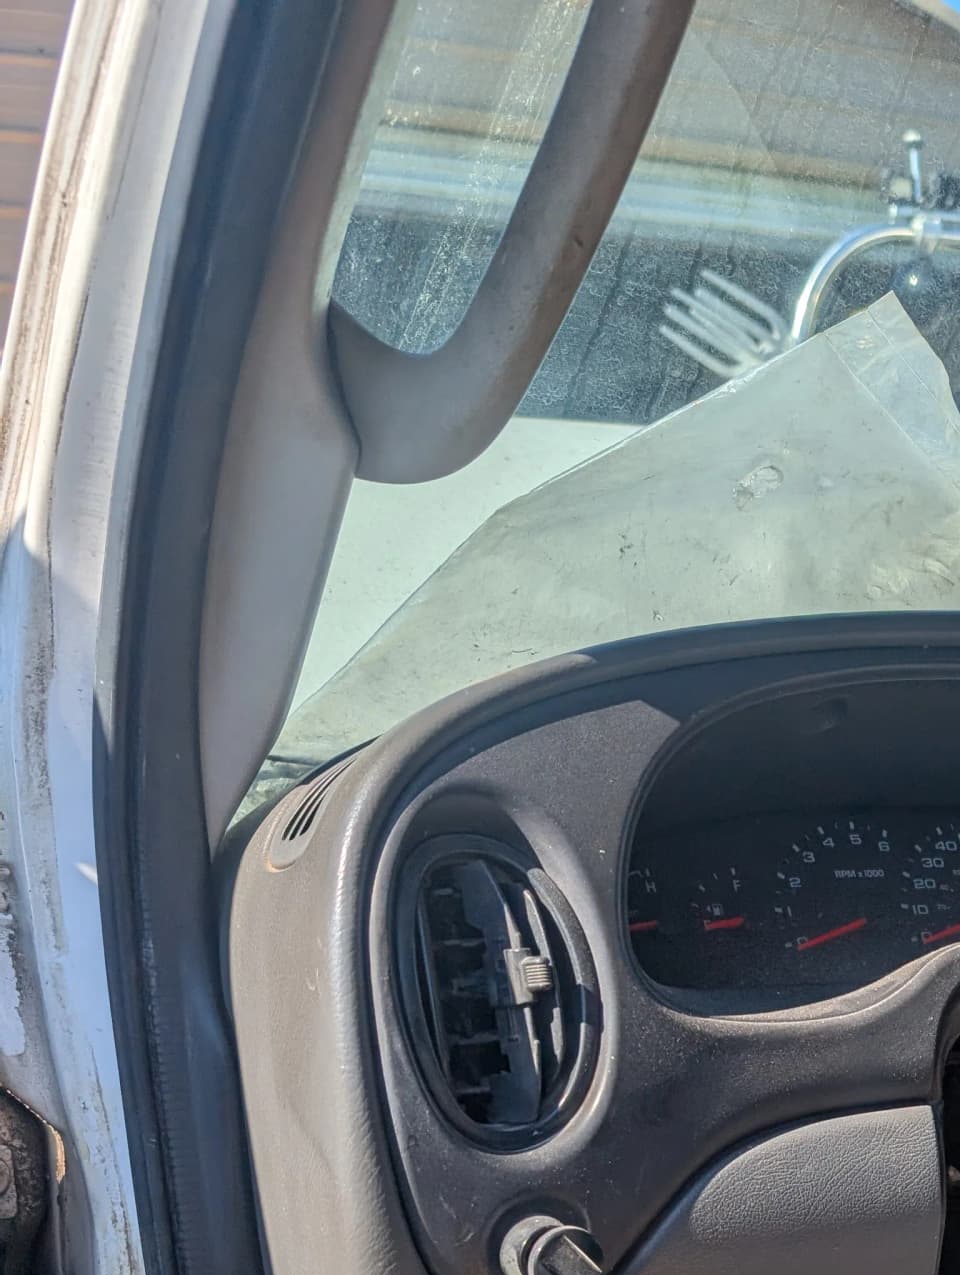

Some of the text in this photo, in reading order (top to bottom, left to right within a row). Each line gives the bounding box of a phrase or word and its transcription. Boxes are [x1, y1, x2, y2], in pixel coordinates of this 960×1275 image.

[822, 837, 835, 848] 4
[849, 834, 862, 845] 5
[878, 841, 890, 852] 6
[935, 841, 957, 851] 40
[802, 851, 815, 863] 3
[921, 858, 944, 868] 30
[833, 870, 857, 878] RPM
[864, 869, 885, 878] 1000
[645, 880, 656, 893] H
[732, 879, 742, 893] F
[789, 877, 802, 888] 2
[913, 878, 936, 889] 20
[912, 904, 928, 915] 10
